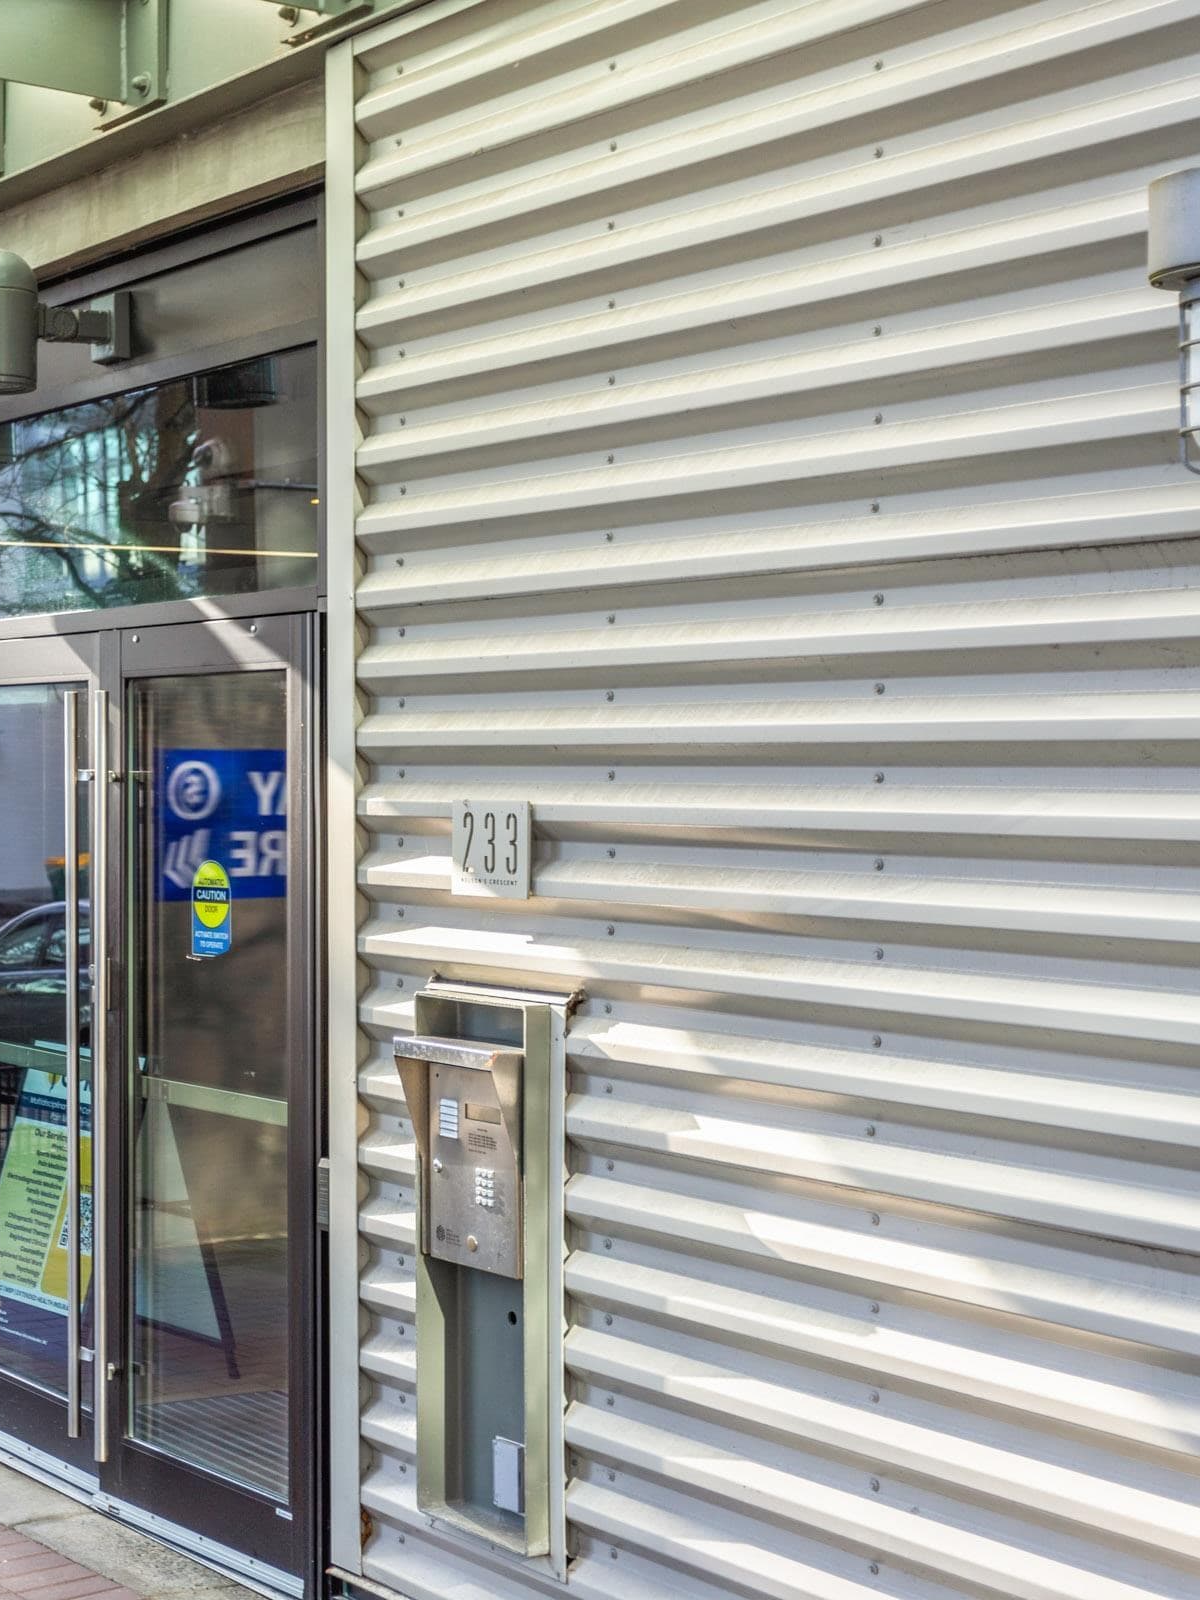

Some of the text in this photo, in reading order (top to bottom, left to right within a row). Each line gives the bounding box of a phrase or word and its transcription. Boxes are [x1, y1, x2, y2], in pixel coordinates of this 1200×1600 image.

[463, 811, 518, 876] 233
[489, 879, 518, 888] CRESCENT
[196, 889, 227, 901] CAUTION
